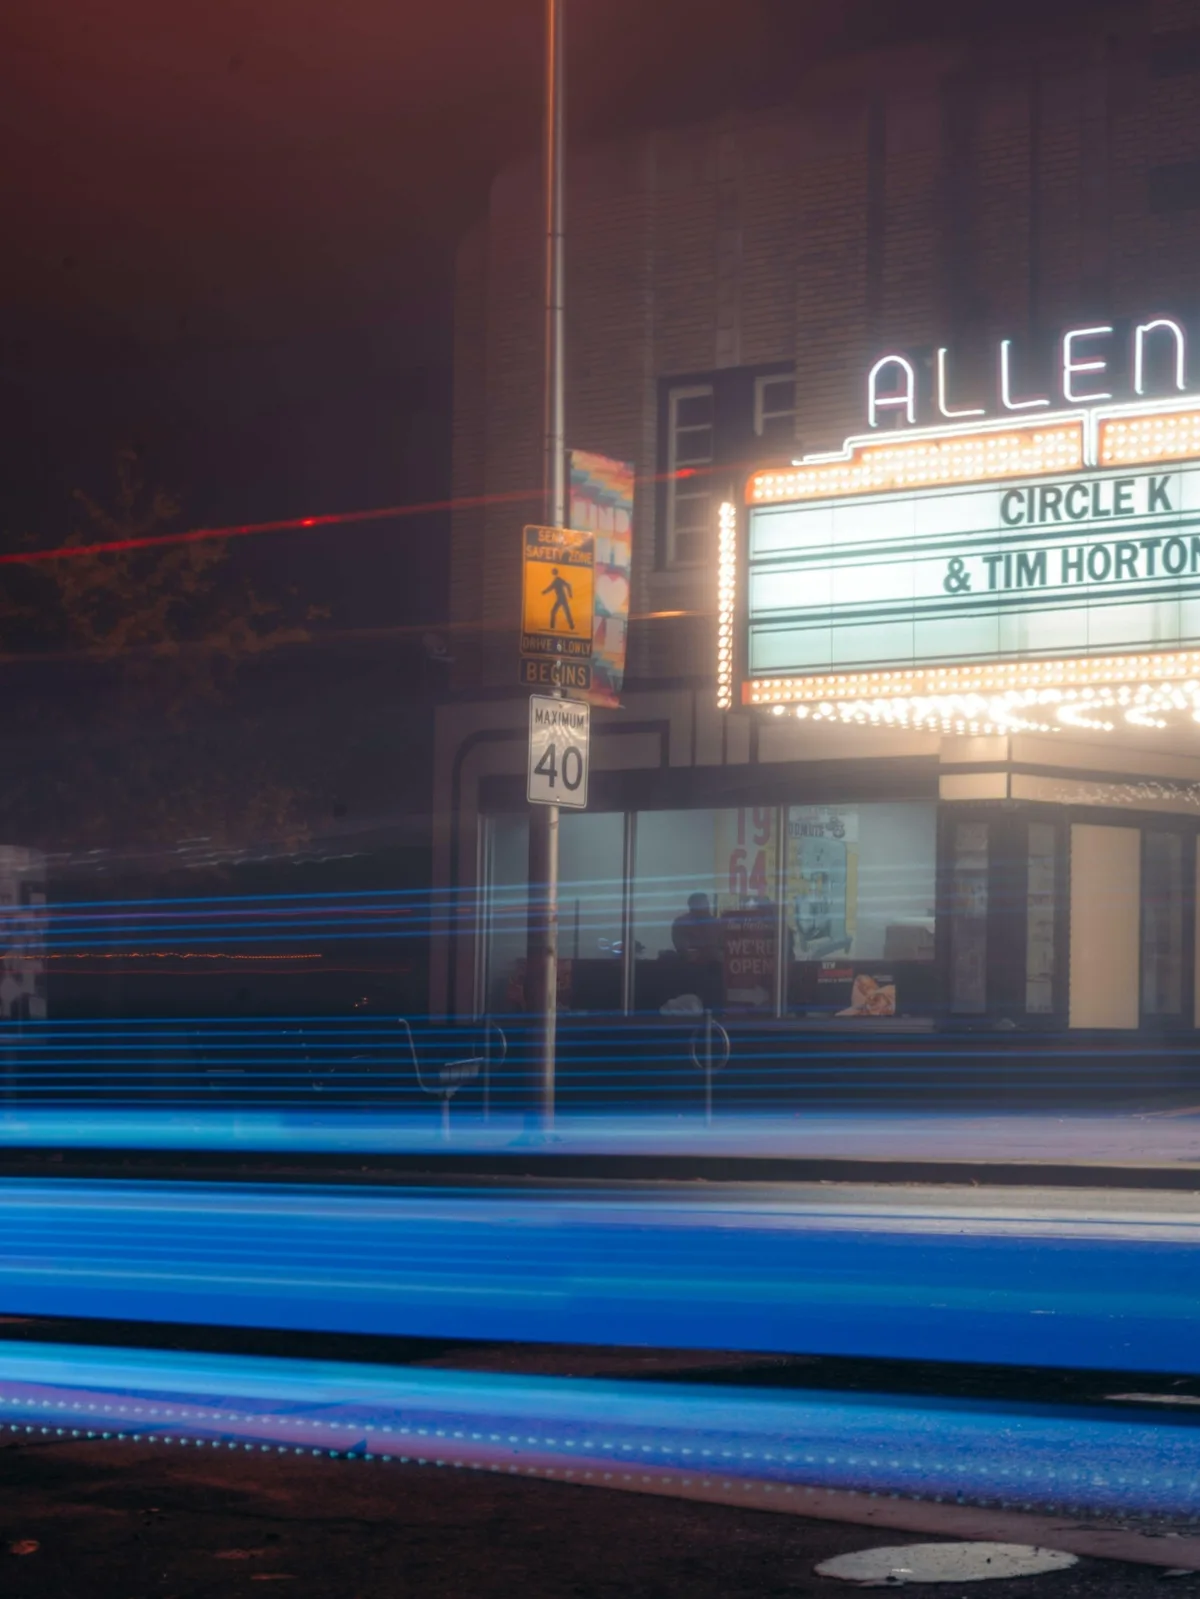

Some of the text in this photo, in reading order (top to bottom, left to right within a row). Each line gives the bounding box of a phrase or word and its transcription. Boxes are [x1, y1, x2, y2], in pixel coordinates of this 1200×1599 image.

[1000, 475, 1173, 525] CIRCLE K
[525, 545, 563, 561] SAFETY
[943, 556, 972, 593] &
[982, 550, 1047, 590] TIM
[522, 637, 552, 651] DRIVE
[527, 662, 586, 687] BEGINS
[534, 707, 585, 730] MAXIMUM
[533, 743, 583, 791] 40
[727, 939, 775, 956] WE'RE
[729, 958, 774, 975] OPEN
